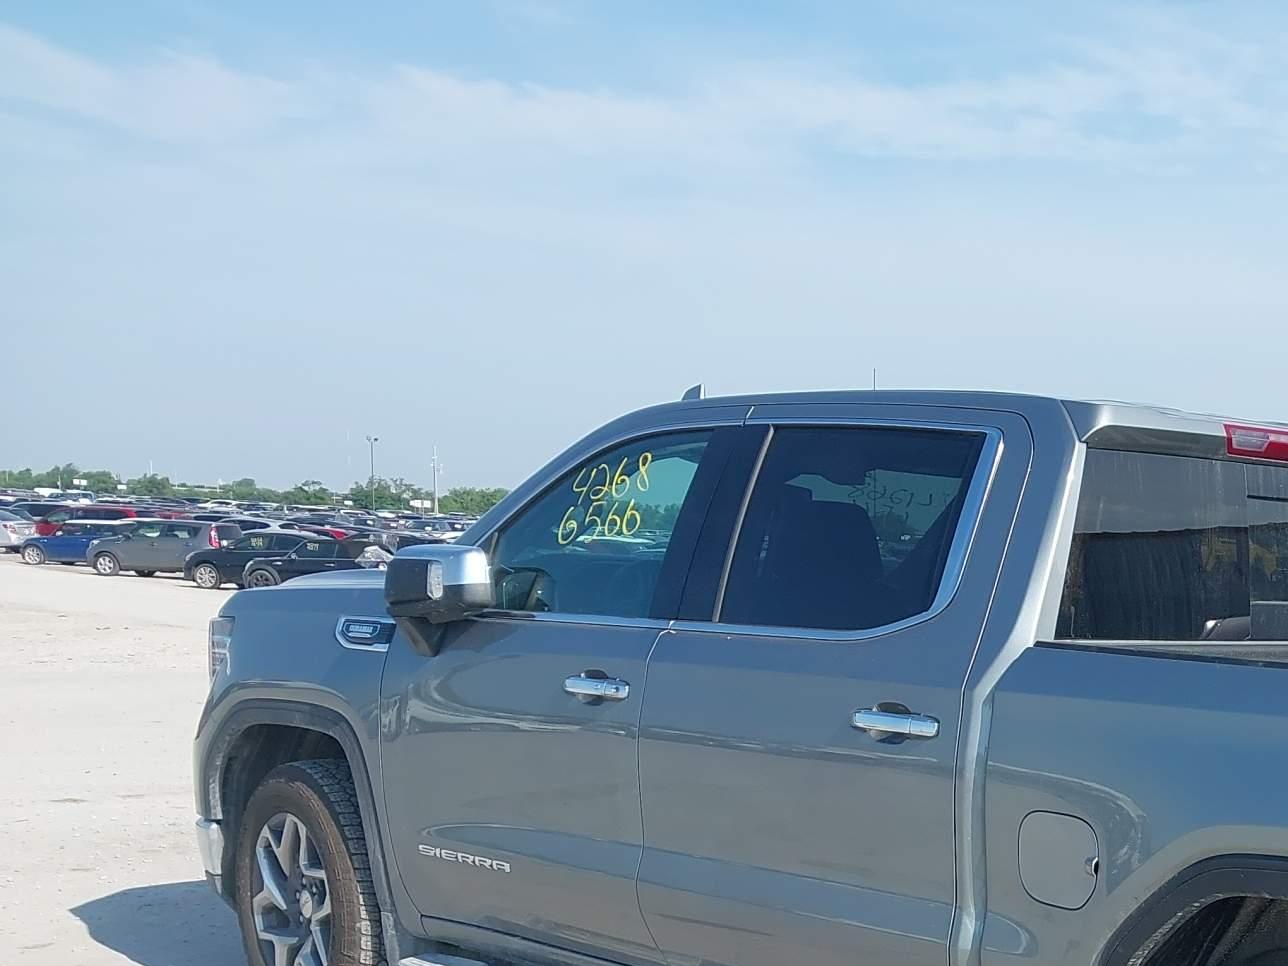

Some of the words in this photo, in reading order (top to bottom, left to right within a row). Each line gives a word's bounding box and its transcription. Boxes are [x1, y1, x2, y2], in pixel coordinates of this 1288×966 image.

[573, 452, 652, 504] 4268
[558, 499, 640, 544] 6566
[418, 844, 511, 873] SIERRA
